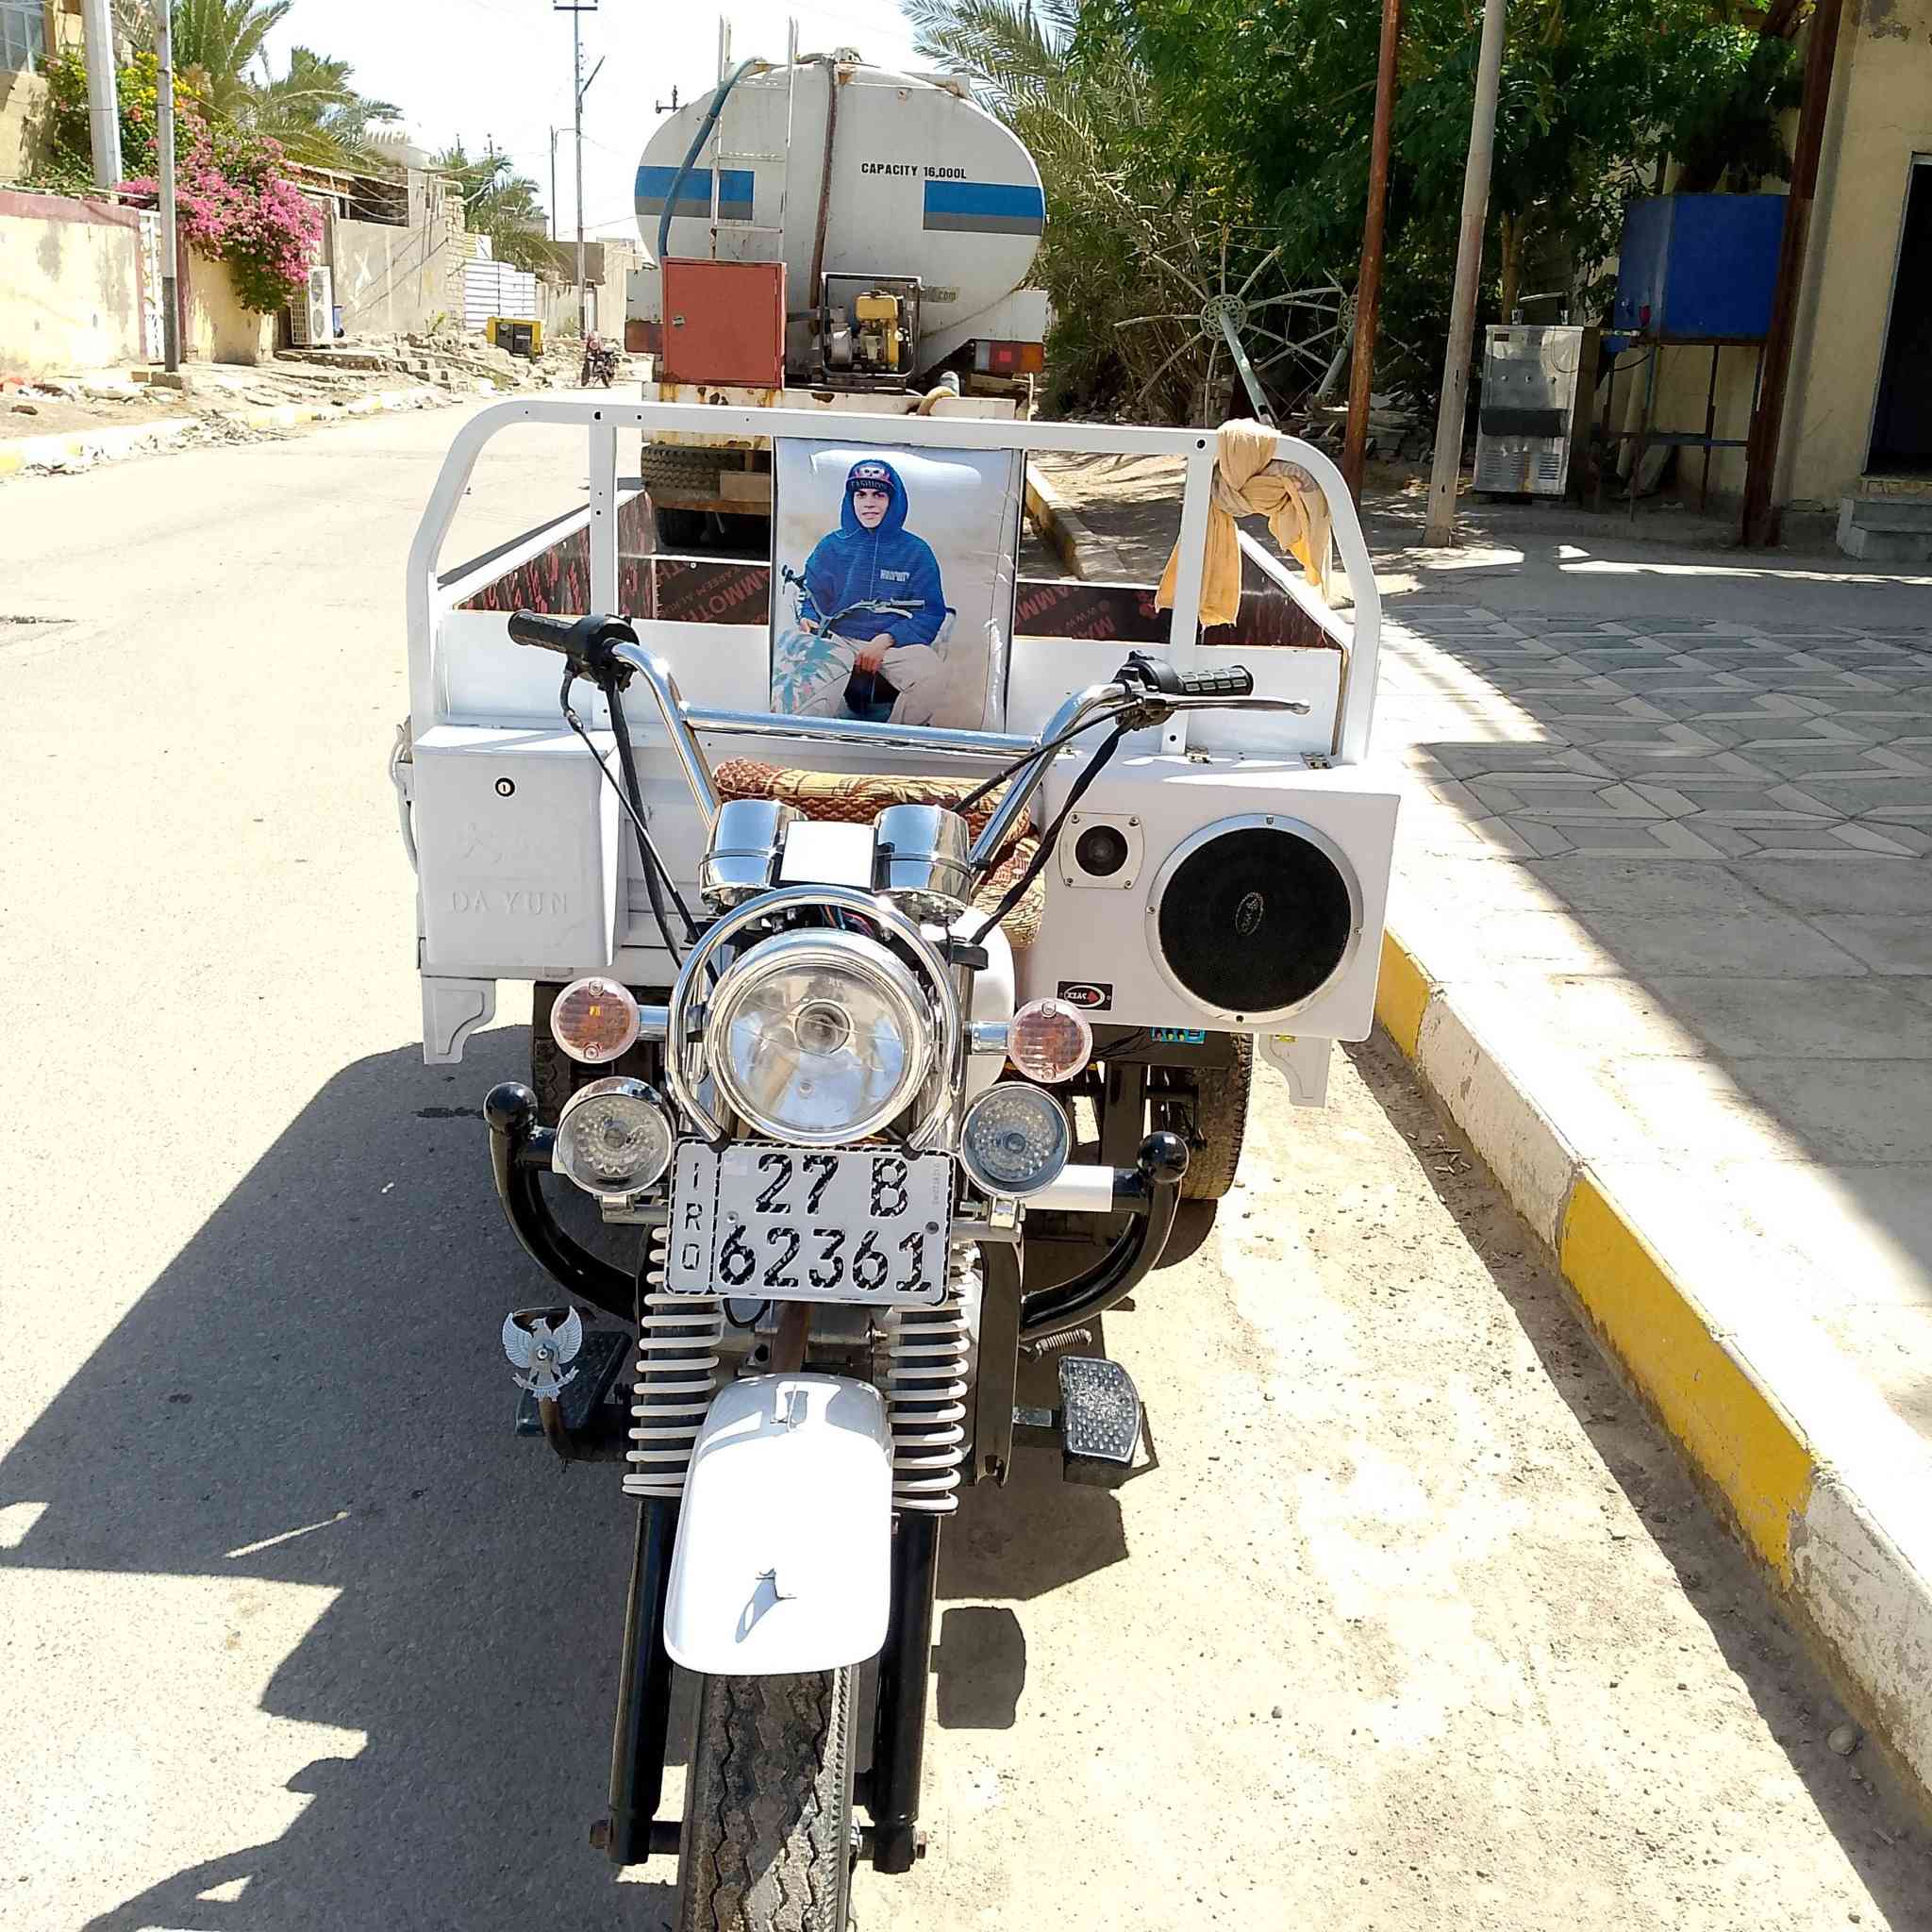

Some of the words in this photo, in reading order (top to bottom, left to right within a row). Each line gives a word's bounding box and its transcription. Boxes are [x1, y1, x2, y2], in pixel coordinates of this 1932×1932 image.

[860, 162, 919, 176] CAPACITY
[923, 166, 968, 179] 16,000L
[452, 890, 491, 914] DA
[504, 890, 568, 915] YUN
[755, 1153, 840, 1215] 27
[869, 1157, 908, 1218] B
[718, 1224, 932, 1292] 62361
